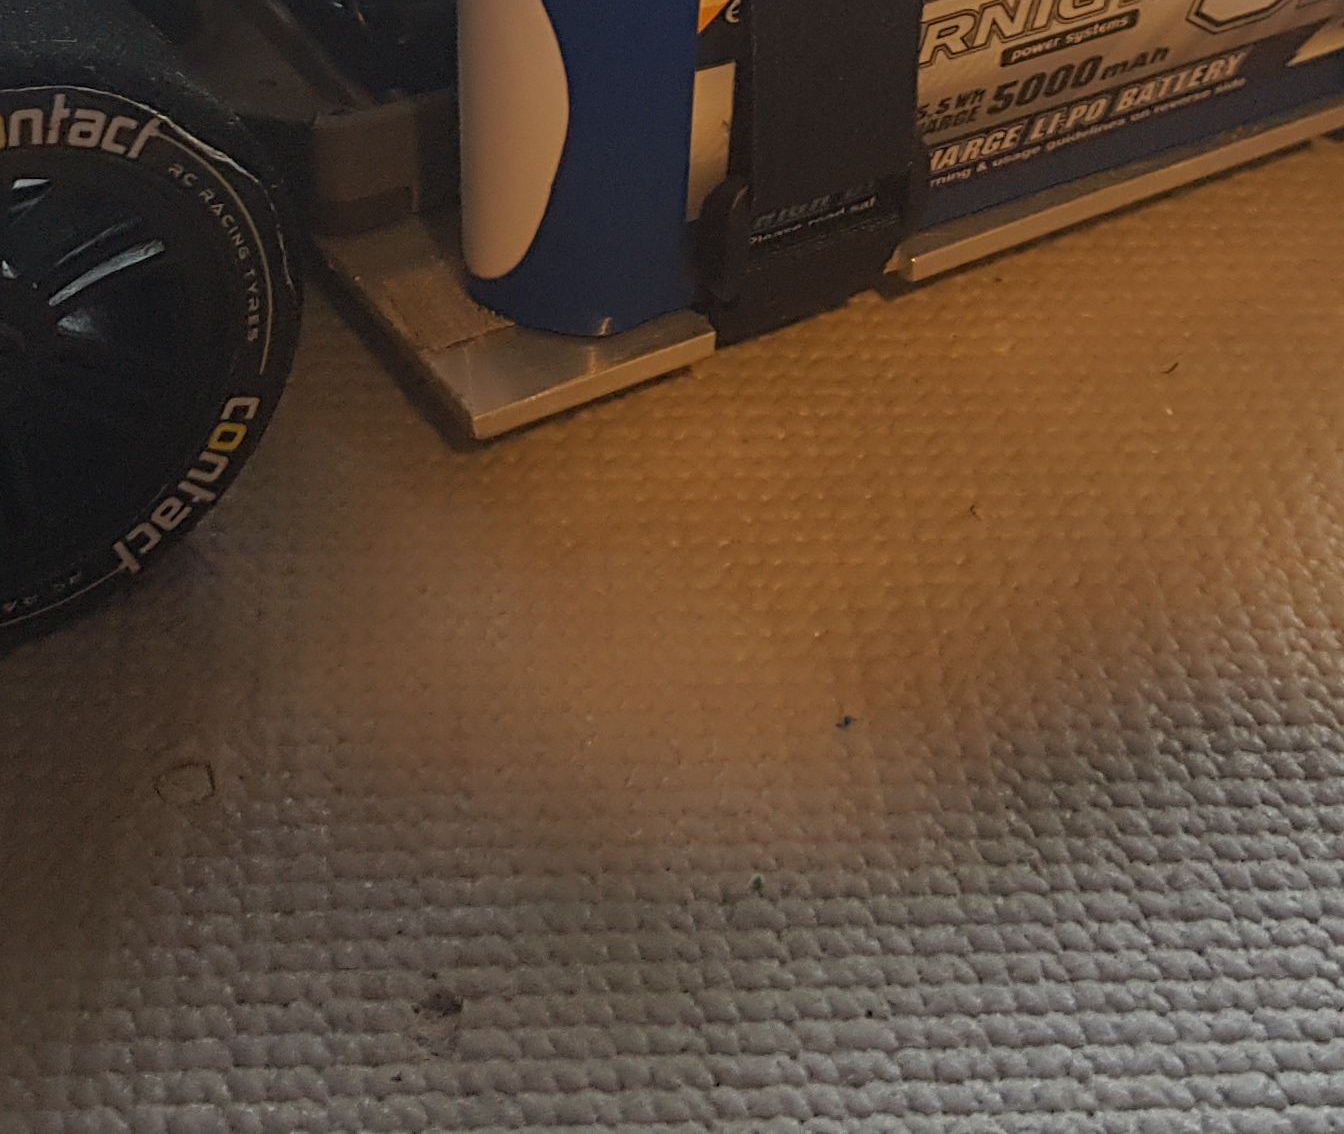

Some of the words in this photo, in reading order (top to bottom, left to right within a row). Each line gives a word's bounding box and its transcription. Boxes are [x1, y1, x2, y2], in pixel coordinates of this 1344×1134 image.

[1011, 38, 1061, 62] power
[1065, 16, 1129, 44] systems
[1114, 52, 1247, 112] BATTERY
[992, 146, 1042, 167] usage
[1046, 118, 1126, 152] guidelines
[168, 163, 199, 187] RC
[198, 188, 250, 261] RACING
[244, 268, 259, 342] TYRES
[112, 396, 261, 573] contact
